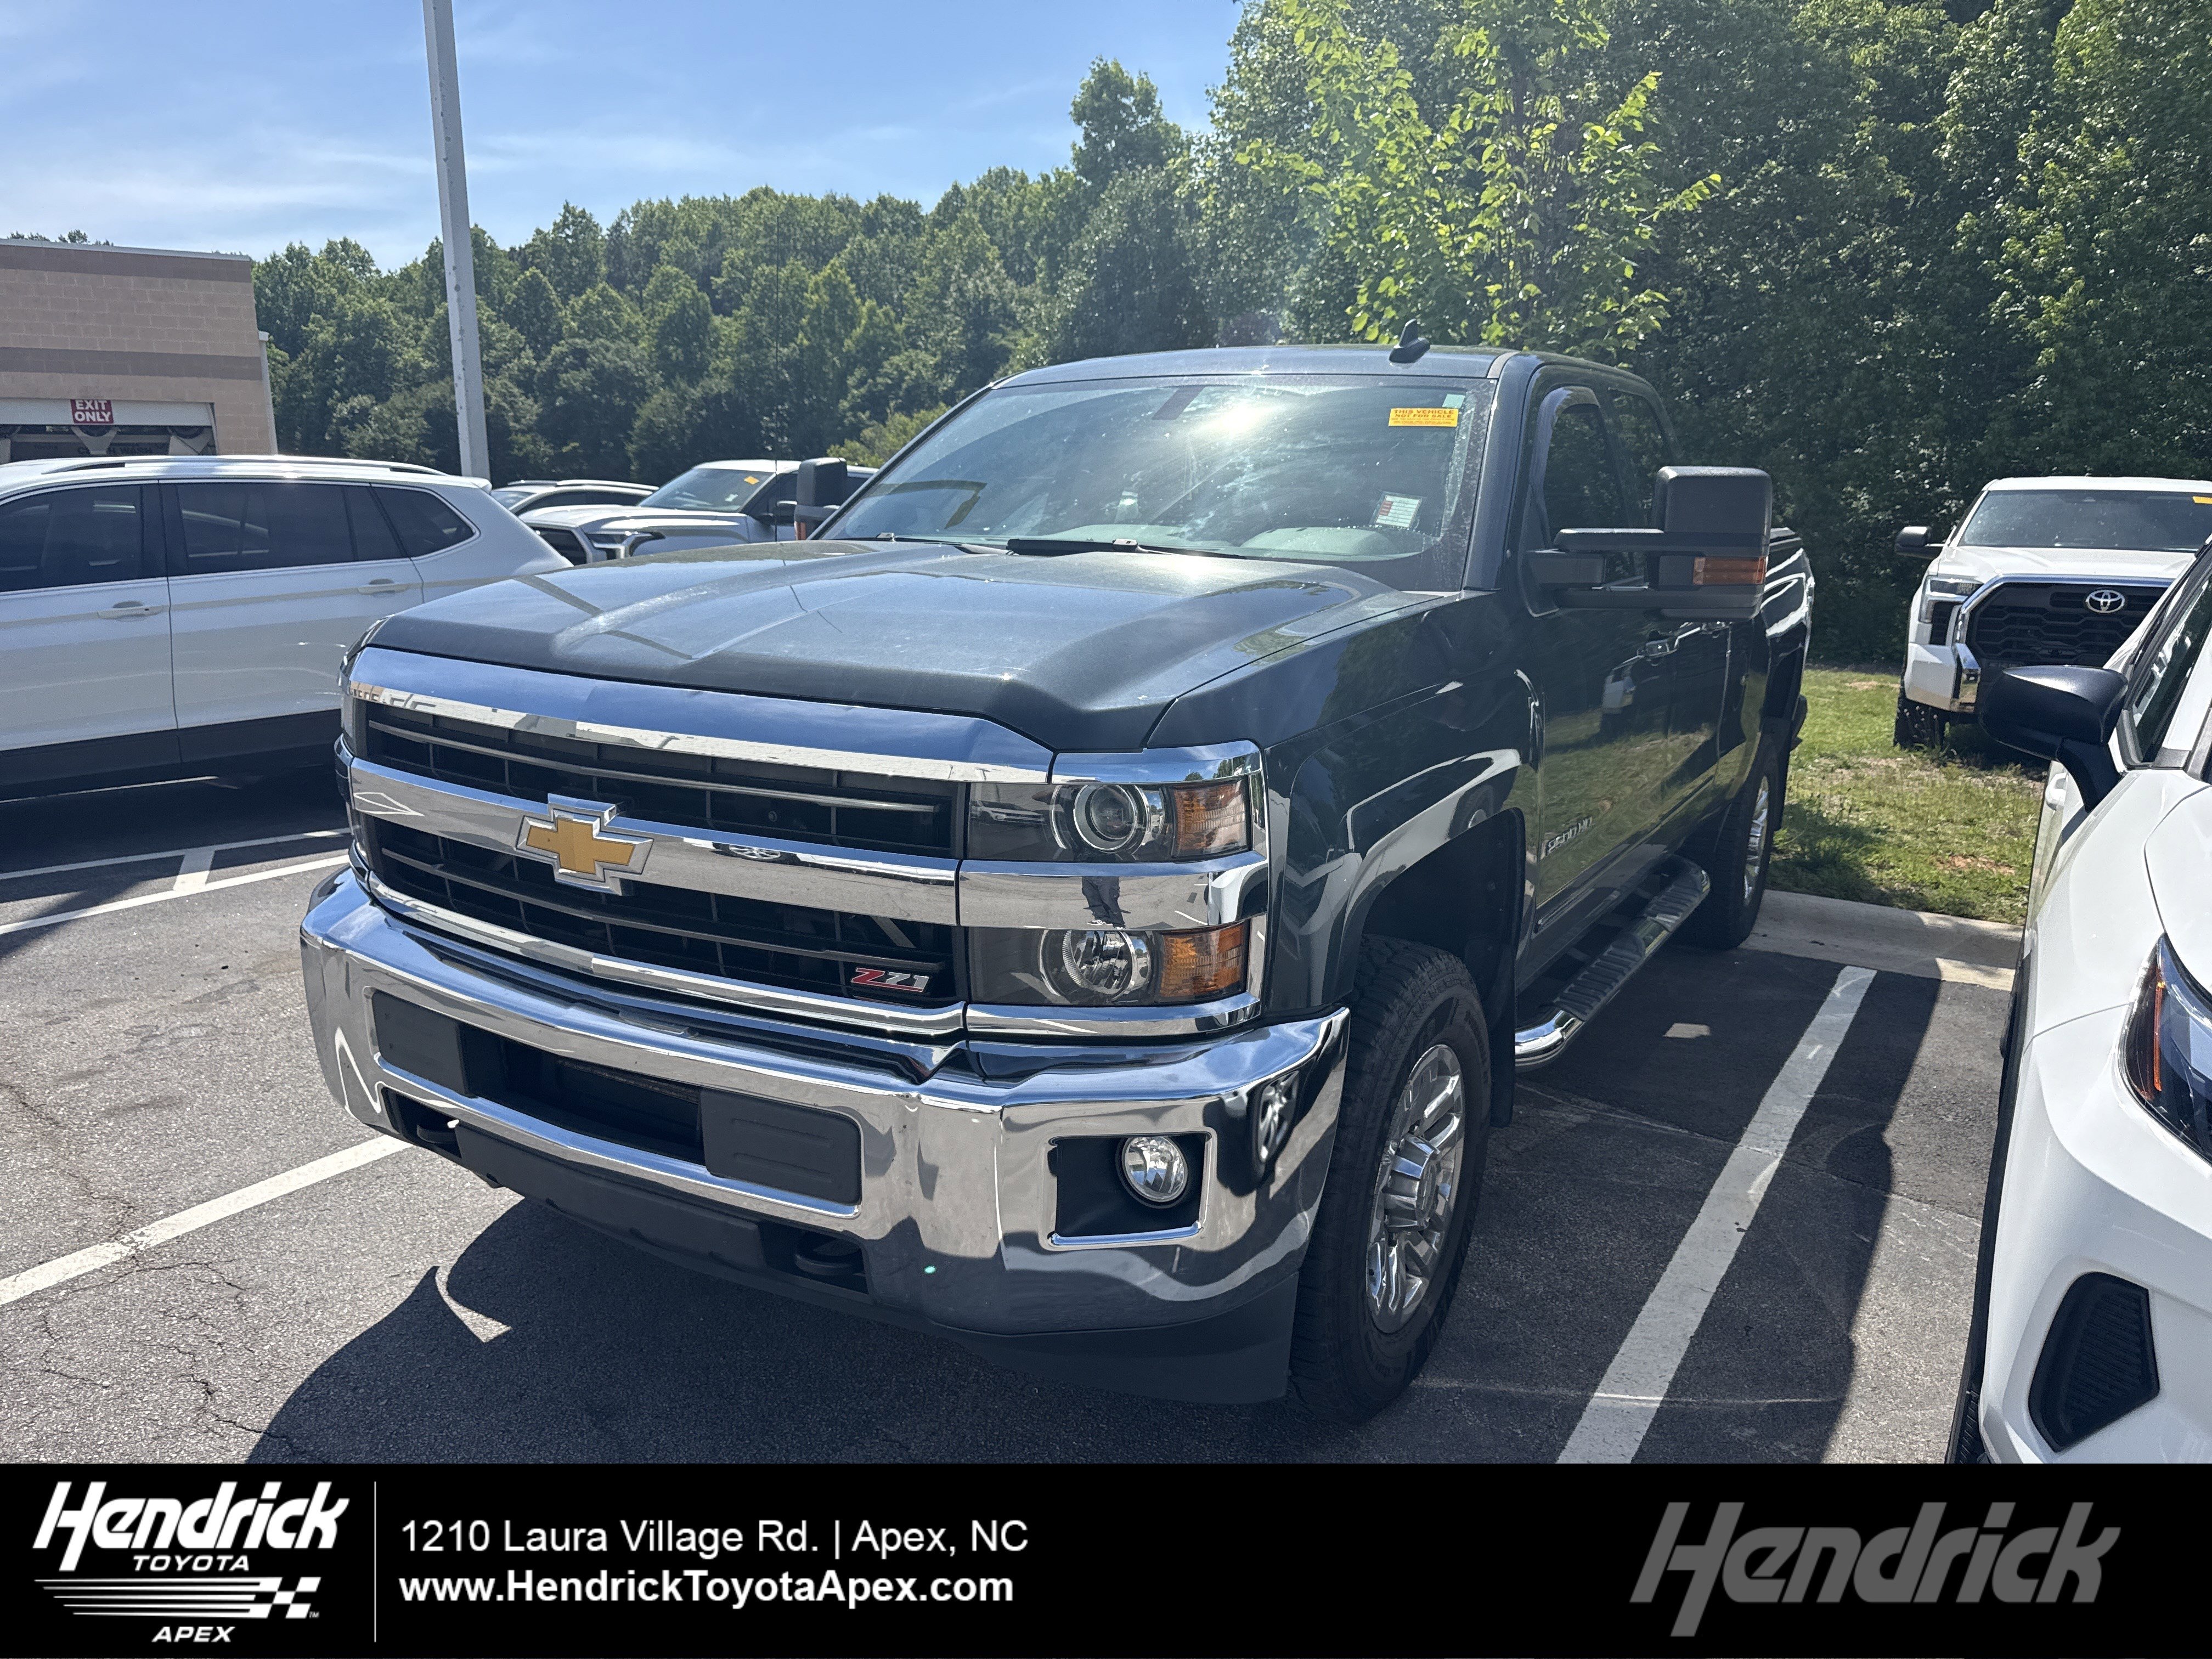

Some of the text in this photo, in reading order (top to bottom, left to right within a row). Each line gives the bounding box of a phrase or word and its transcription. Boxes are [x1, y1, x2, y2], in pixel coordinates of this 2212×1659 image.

[75, 400, 107, 410] EXIT
[75, 411, 111, 422] ONLY
[851, 967, 930, 992] Z71
